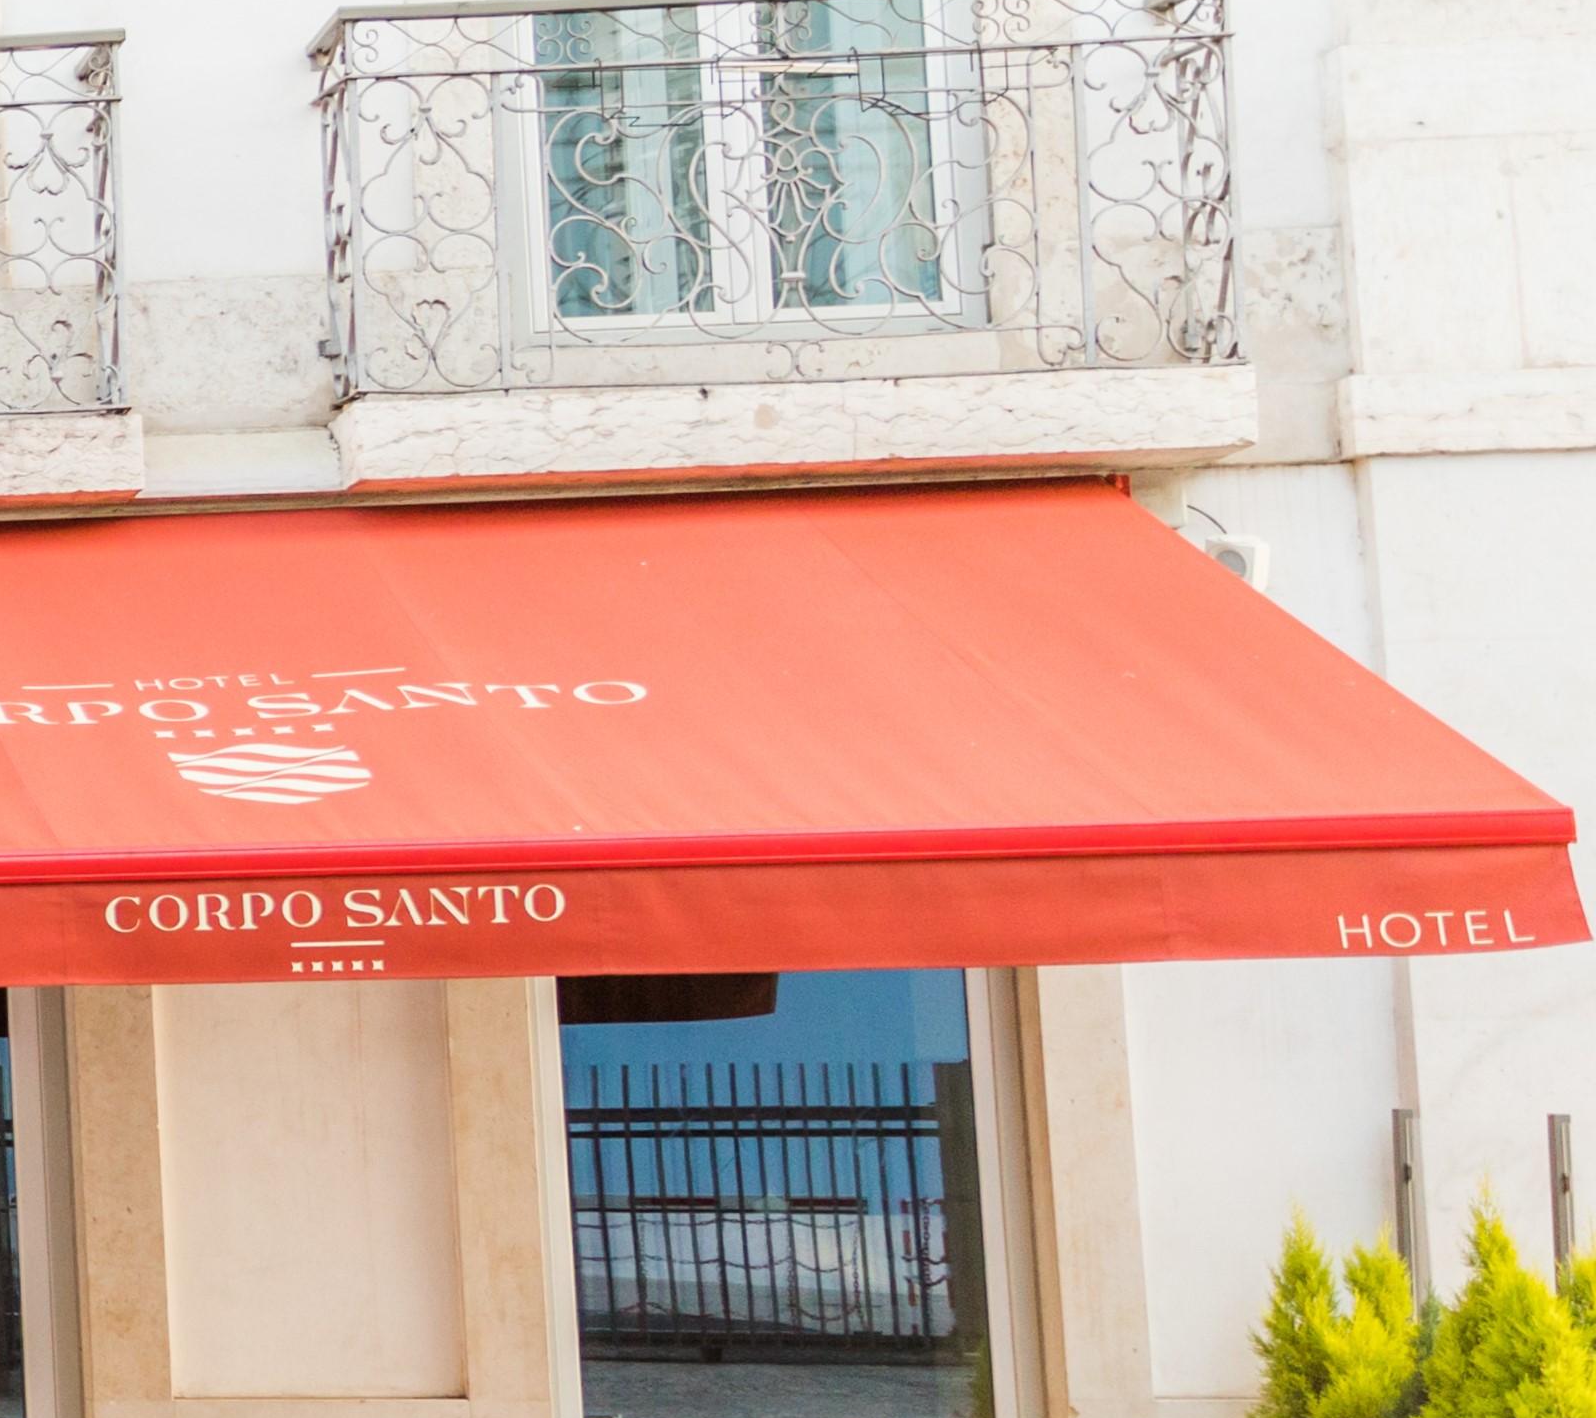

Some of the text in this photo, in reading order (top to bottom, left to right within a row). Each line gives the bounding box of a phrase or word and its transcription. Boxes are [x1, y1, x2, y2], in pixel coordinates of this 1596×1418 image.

[133, 672, 297, 691] HOTEL
[247, 680, 649, 721] SANTO
[104, 883, 567, 934] CORPO SANTO
[1337, 908, 1535, 950] HOTEL
